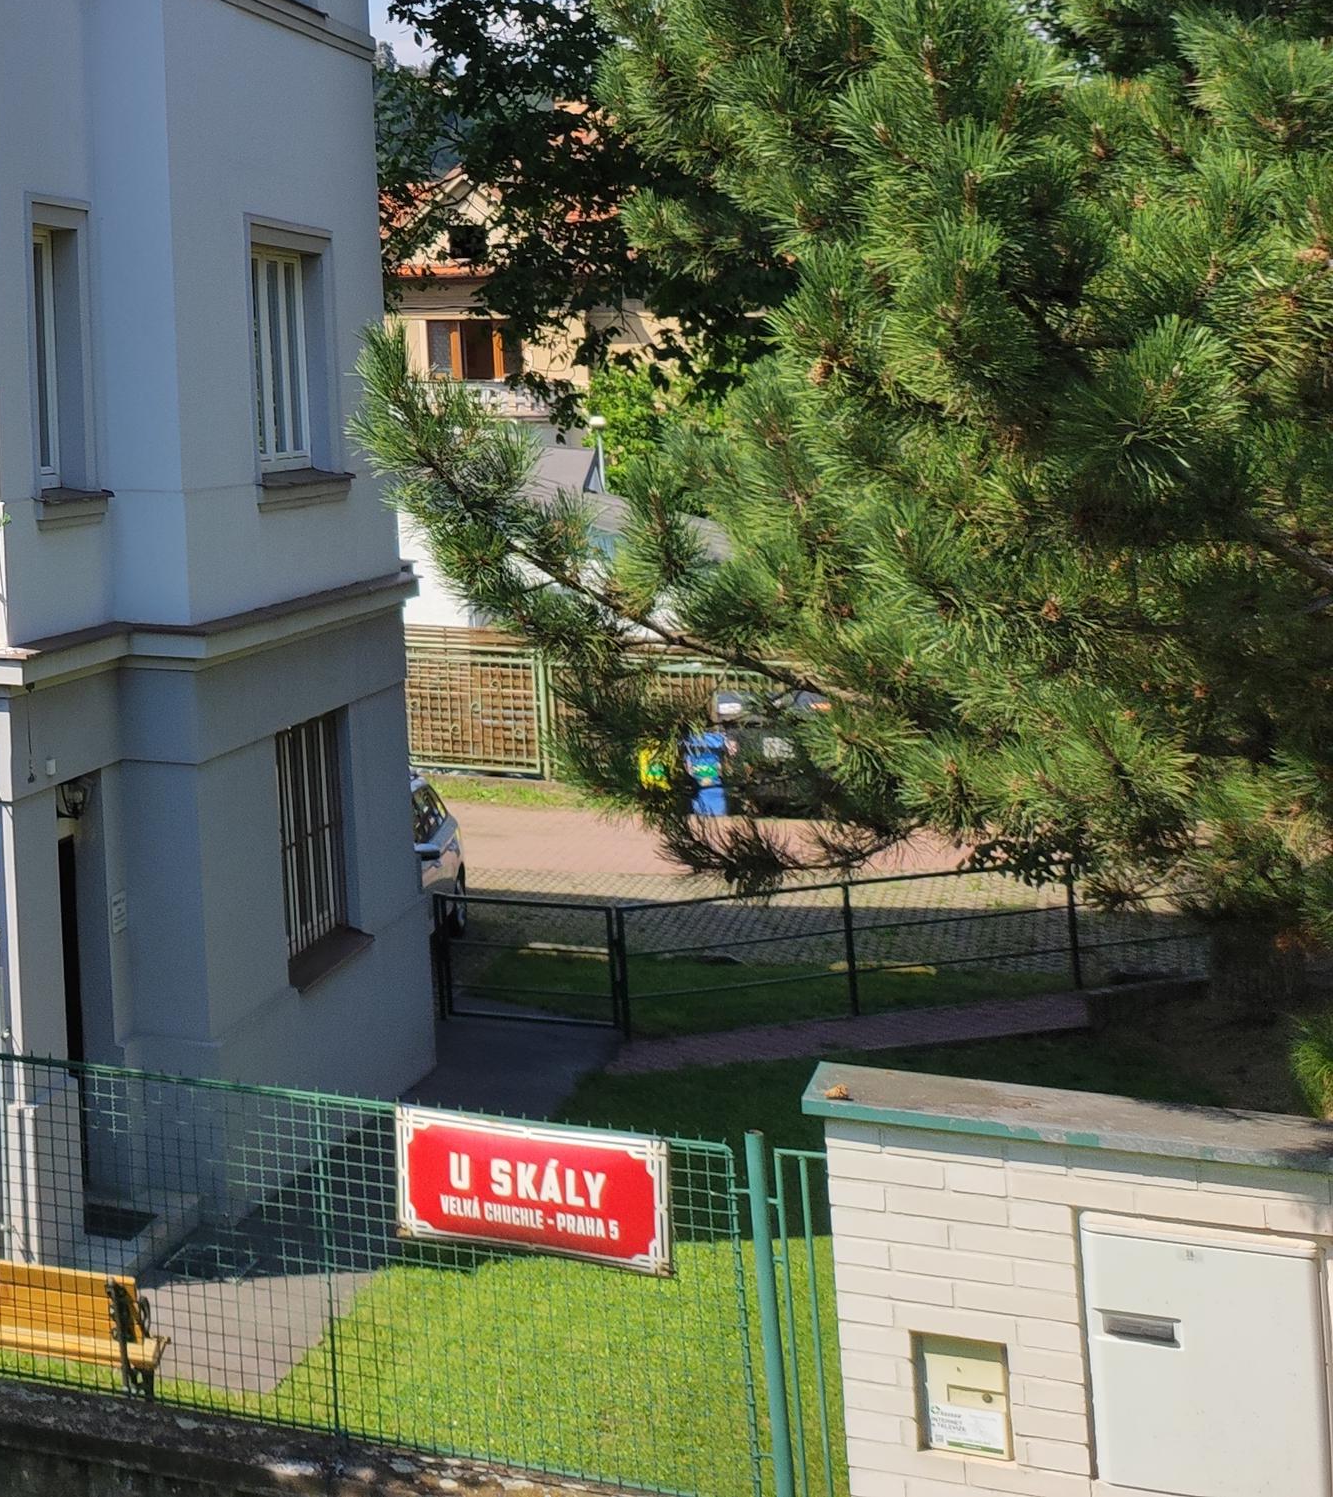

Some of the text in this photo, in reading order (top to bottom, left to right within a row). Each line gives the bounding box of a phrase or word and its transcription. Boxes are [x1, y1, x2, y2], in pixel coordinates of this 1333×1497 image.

[449, 1151, 606, 1209] U SKÁLY
[439, 1193, 482, 1220] VELKÁ
[483, 1200, 544, 1230] CHUCHLE
[556, 1212, 606, 1239] PRAHA
[608, 1219, 620, 1241] 5
